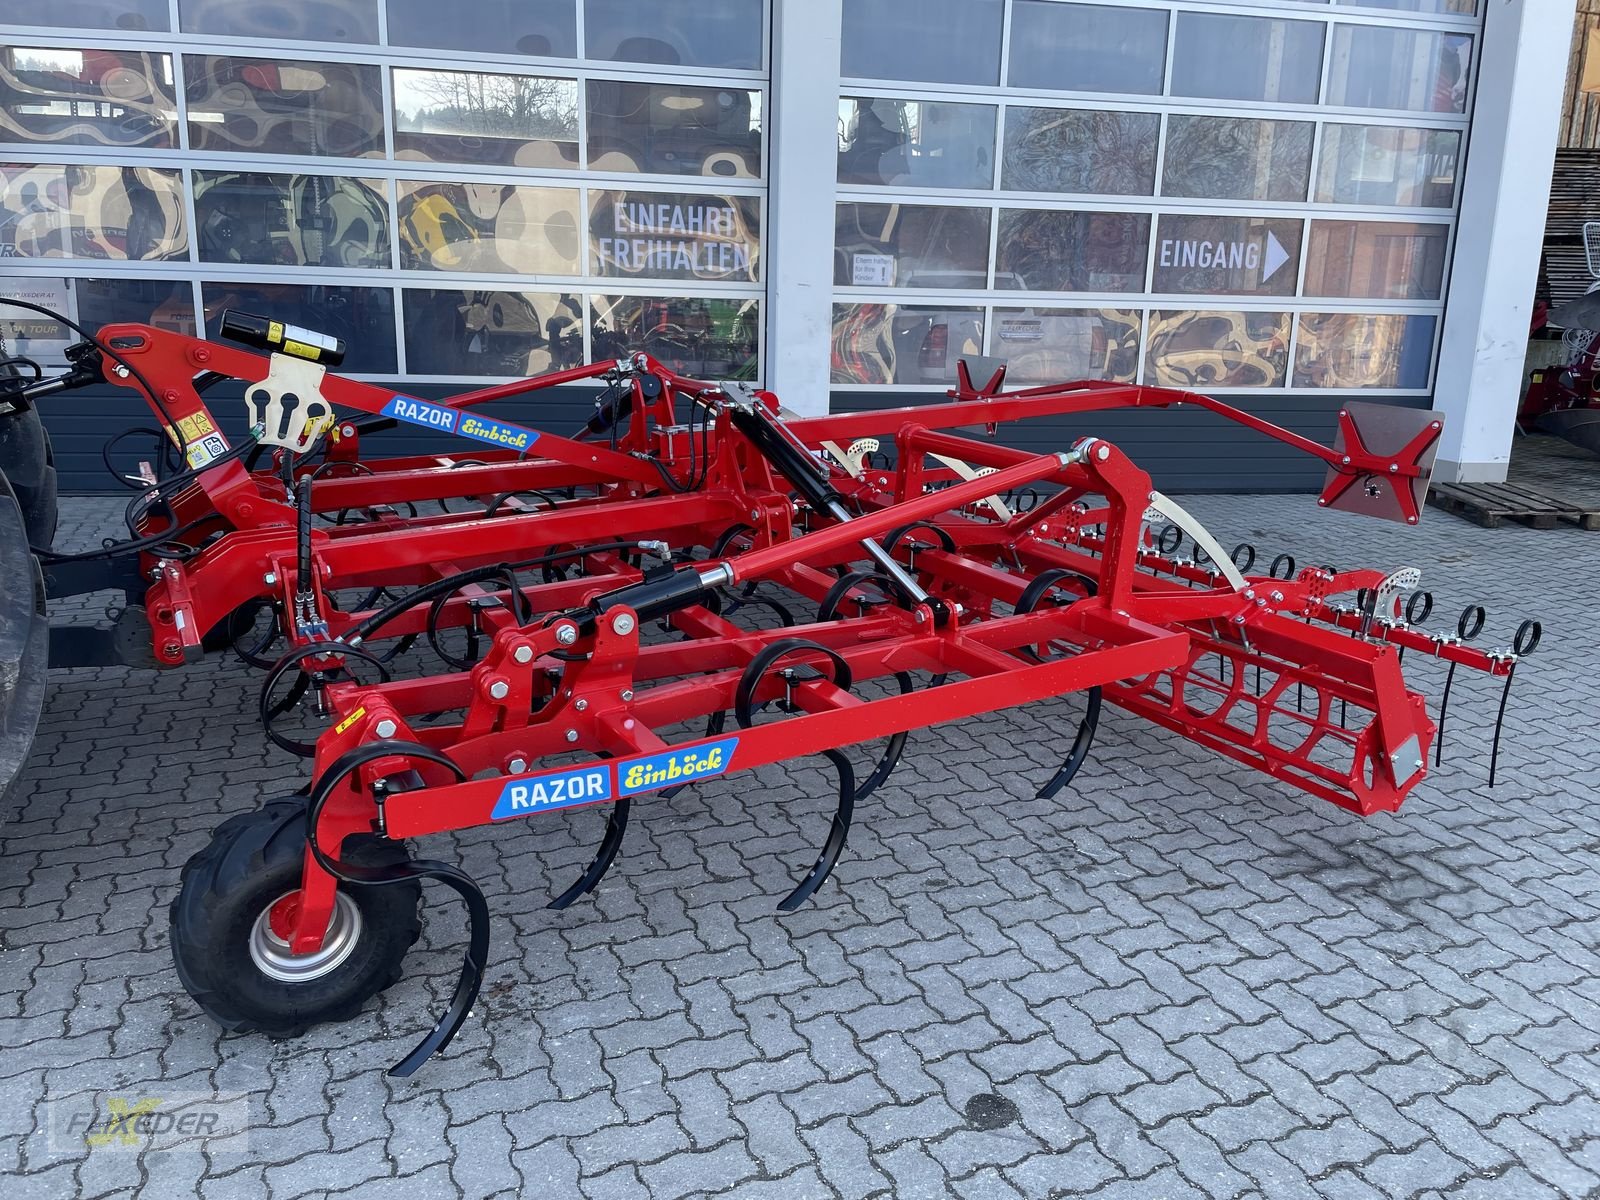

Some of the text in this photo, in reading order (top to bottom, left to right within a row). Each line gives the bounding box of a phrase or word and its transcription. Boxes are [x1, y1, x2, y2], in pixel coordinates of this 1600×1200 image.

[614, 202, 736, 236] EINFAHRT
[600, 238, 749, 272] FREIHALTEN
[1160, 240, 1259, 269] EINGANG
[30, 325, 59, 335] TOUR
[394, 399, 528, 448] RAZOR Einböck
[511, 748, 722, 810] RAZOR Einböck
